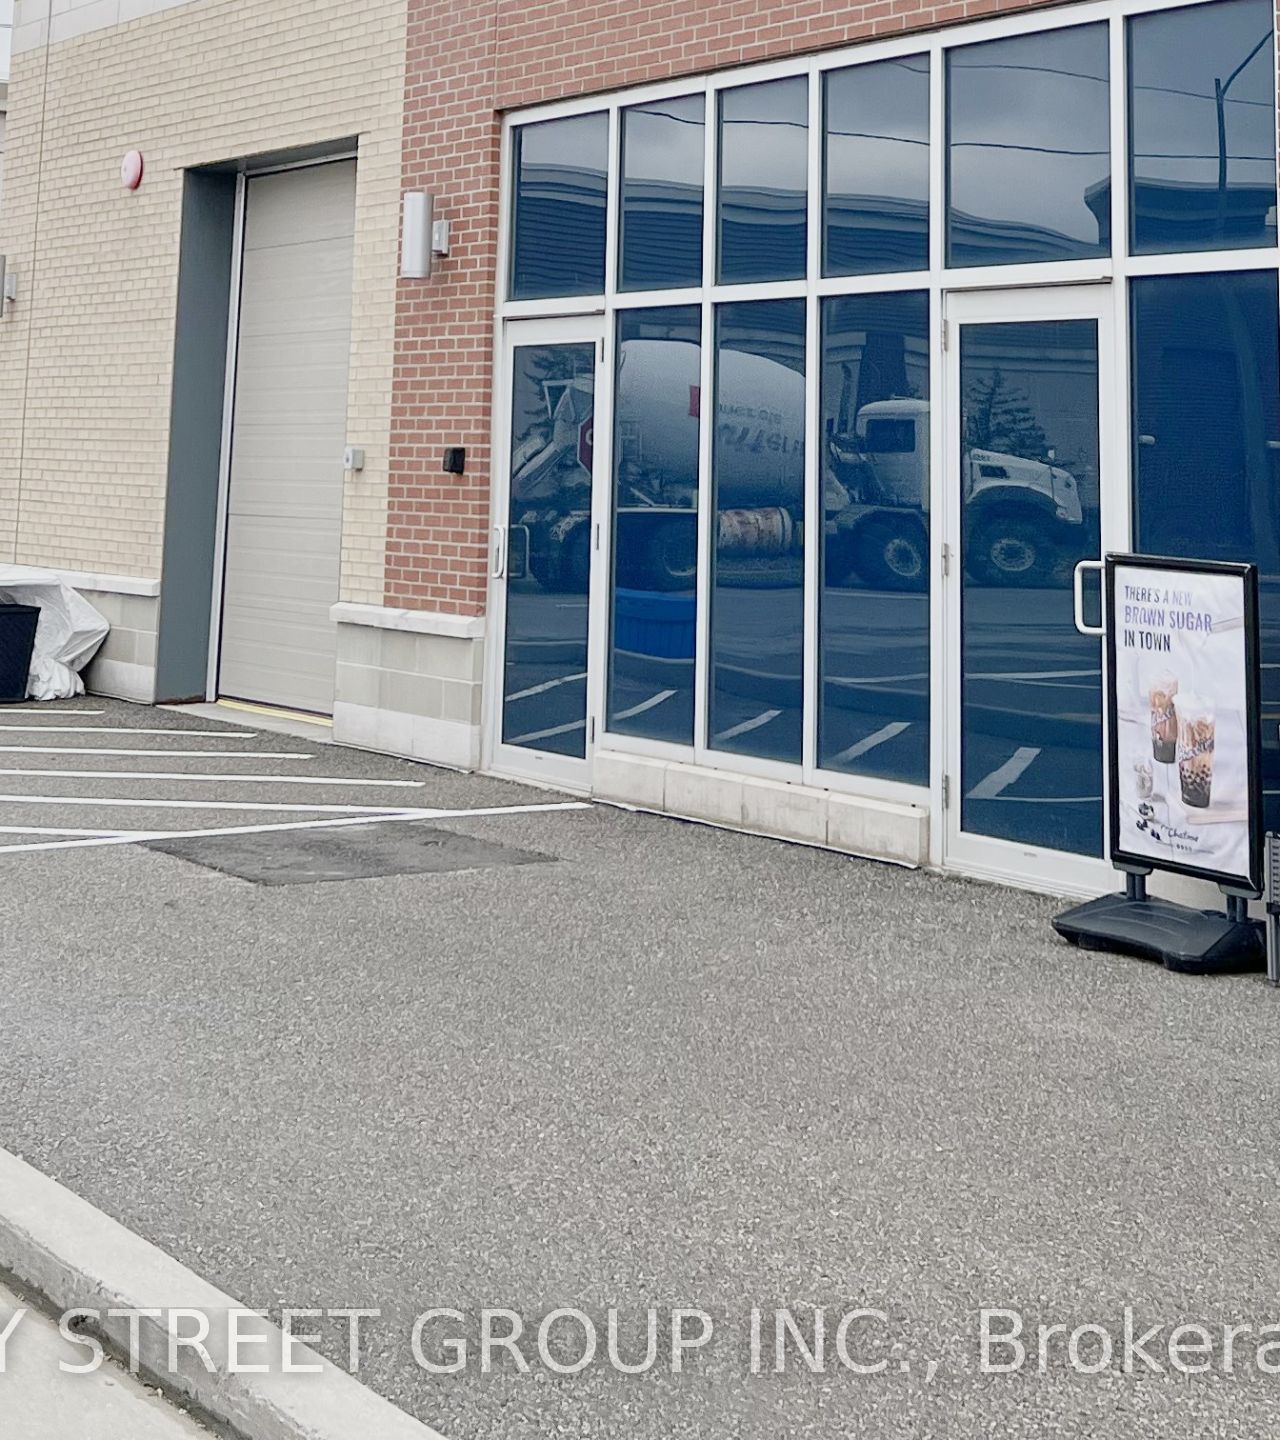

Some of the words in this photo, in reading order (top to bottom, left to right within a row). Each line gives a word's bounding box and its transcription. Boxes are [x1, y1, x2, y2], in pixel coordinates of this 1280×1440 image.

[1172, 590, 1193, 606] NEW
[1125, 605, 1165, 627] BROWN
[1169, 610, 1212, 632] SUGAR
[1124, 629, 1135, 648] IN
[1139, 631, 1171, 652] TOWN
